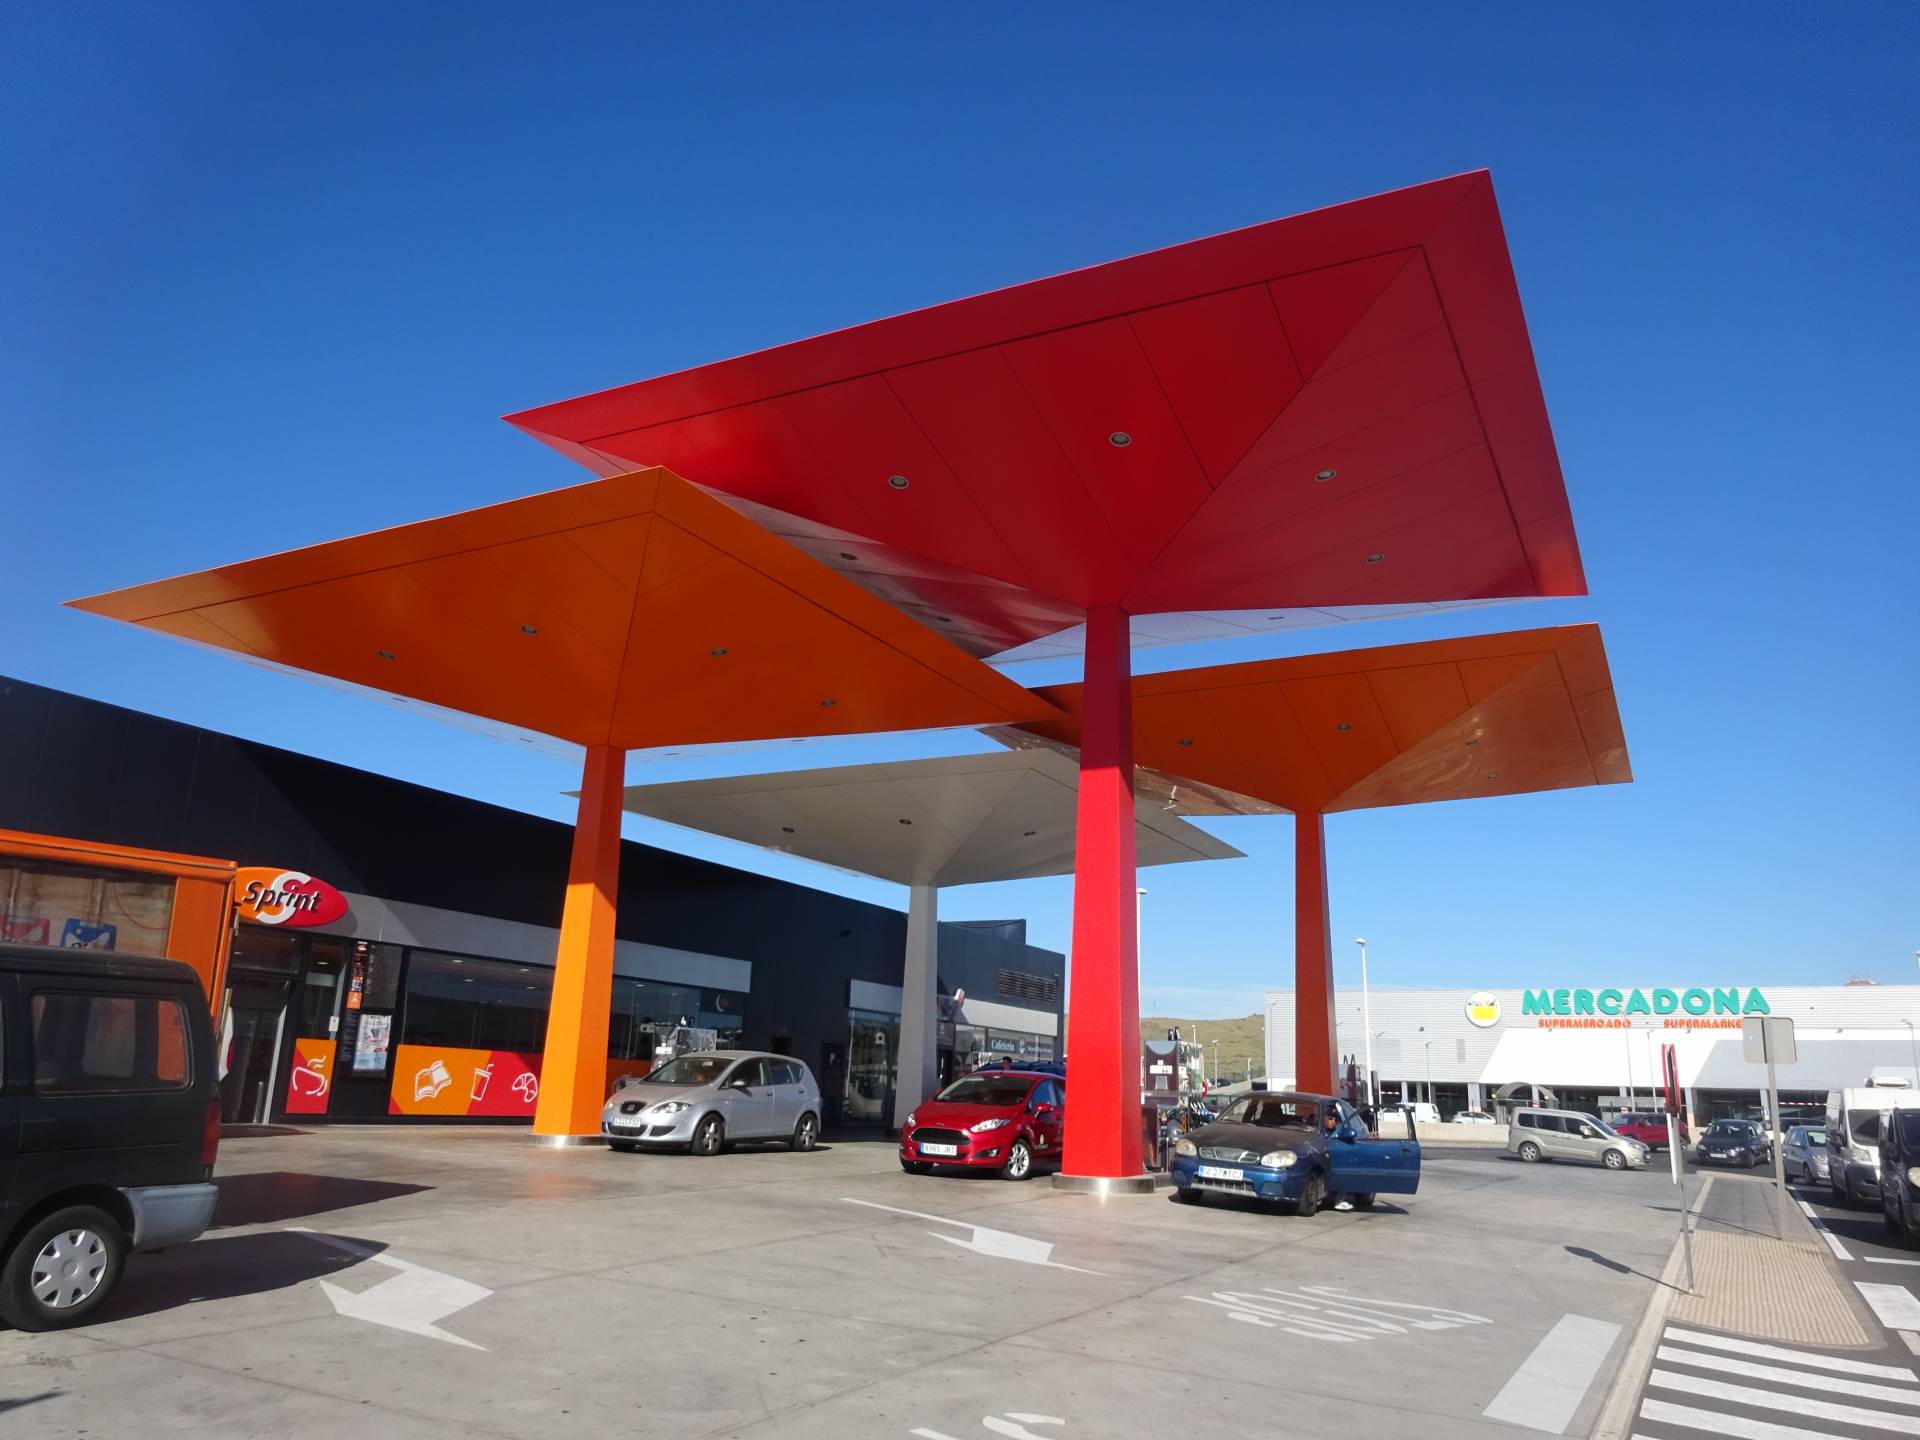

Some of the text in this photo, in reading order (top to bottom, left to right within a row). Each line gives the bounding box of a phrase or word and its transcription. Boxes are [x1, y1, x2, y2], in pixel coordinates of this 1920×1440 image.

[241, 880, 320, 912] Sprint
[1521, 987, 1770, 1015] MERCADONA
[1538, 1017, 1743, 1029] SUPERMERCADO SUPERMARKE
